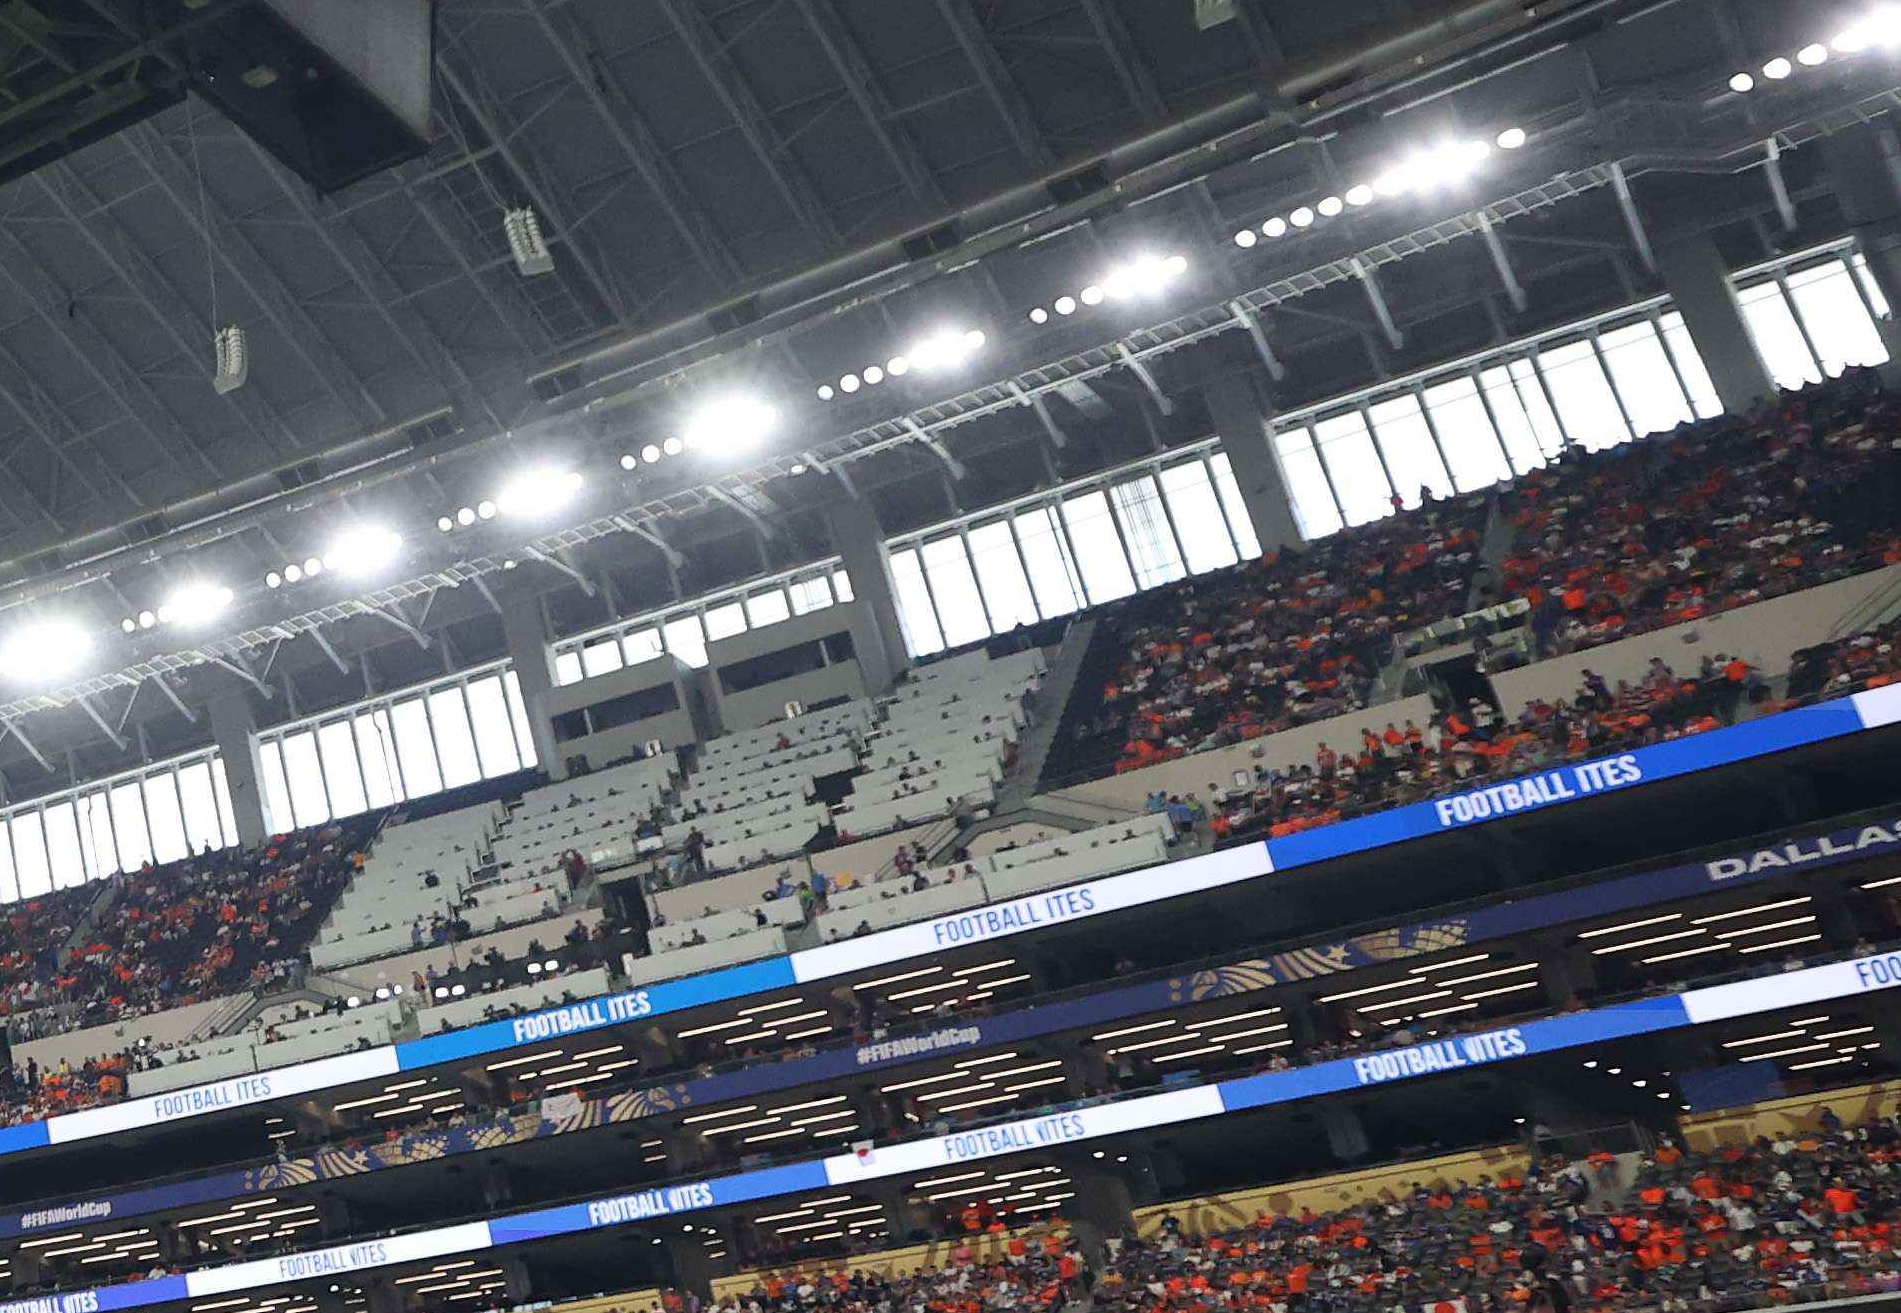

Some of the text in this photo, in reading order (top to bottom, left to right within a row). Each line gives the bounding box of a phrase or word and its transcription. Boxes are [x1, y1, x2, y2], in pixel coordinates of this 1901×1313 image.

[1436, 772, 1575, 827] FOOTBALL
[934, 902, 1041, 946] FOOTBALL
[513, 1005, 603, 1043] FOOTBALL
[857, 1027, 981, 1064] #FIFAWorldCup
[1352, 1040, 1466, 1084] FOOTBALL
[154, 1088, 231, 1119] FOOTBALL
[944, 1124, 1034, 1161] FOOTBALL
[21, 1199, 112, 1230] #FIFAWorldCup
[588, 1193, 670, 1224] FOOTBALL
[280, 1253, 346, 1279] FOOTBALL
